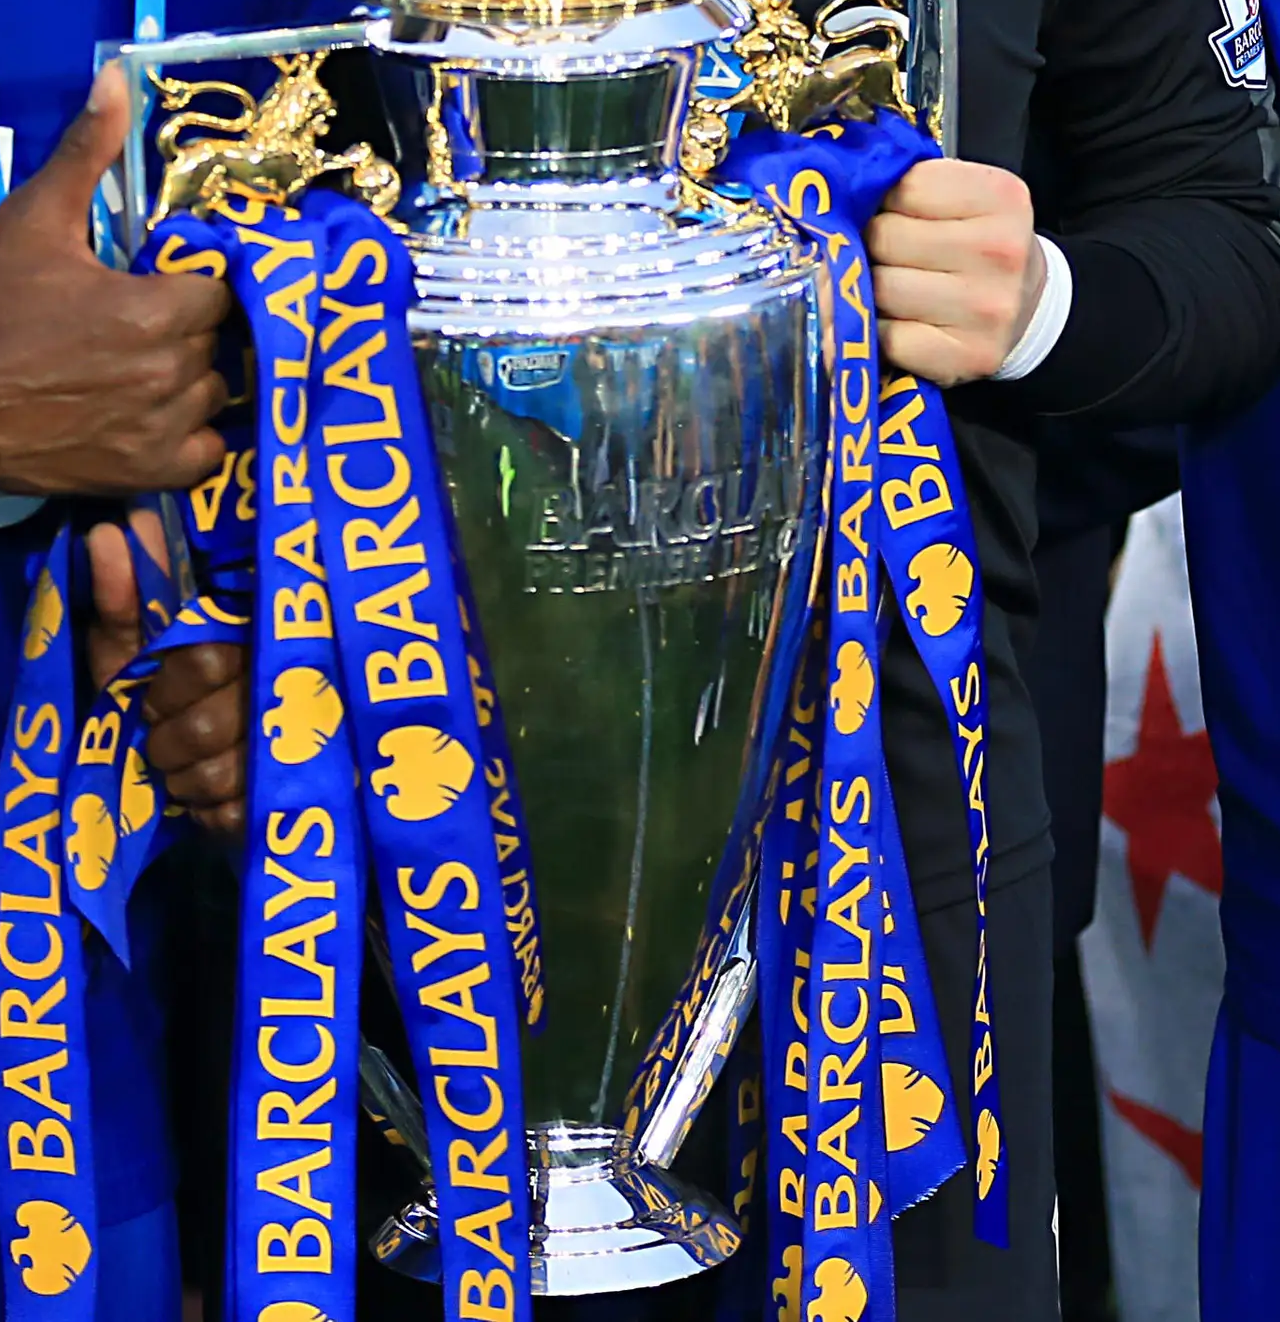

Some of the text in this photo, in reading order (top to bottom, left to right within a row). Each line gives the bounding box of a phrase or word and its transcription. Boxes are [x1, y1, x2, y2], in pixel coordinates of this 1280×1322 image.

[1234, 18, 1262, 56] BARC
[320, 238, 448, 704] BARCLAYS
[526, 463, 798, 552] BARCLA
[257, 806, 336, 1275] BARCLAYS
[396, 861, 517, 1322] BARCLAYS
[814, 776, 871, 1232] BARCLAYS
